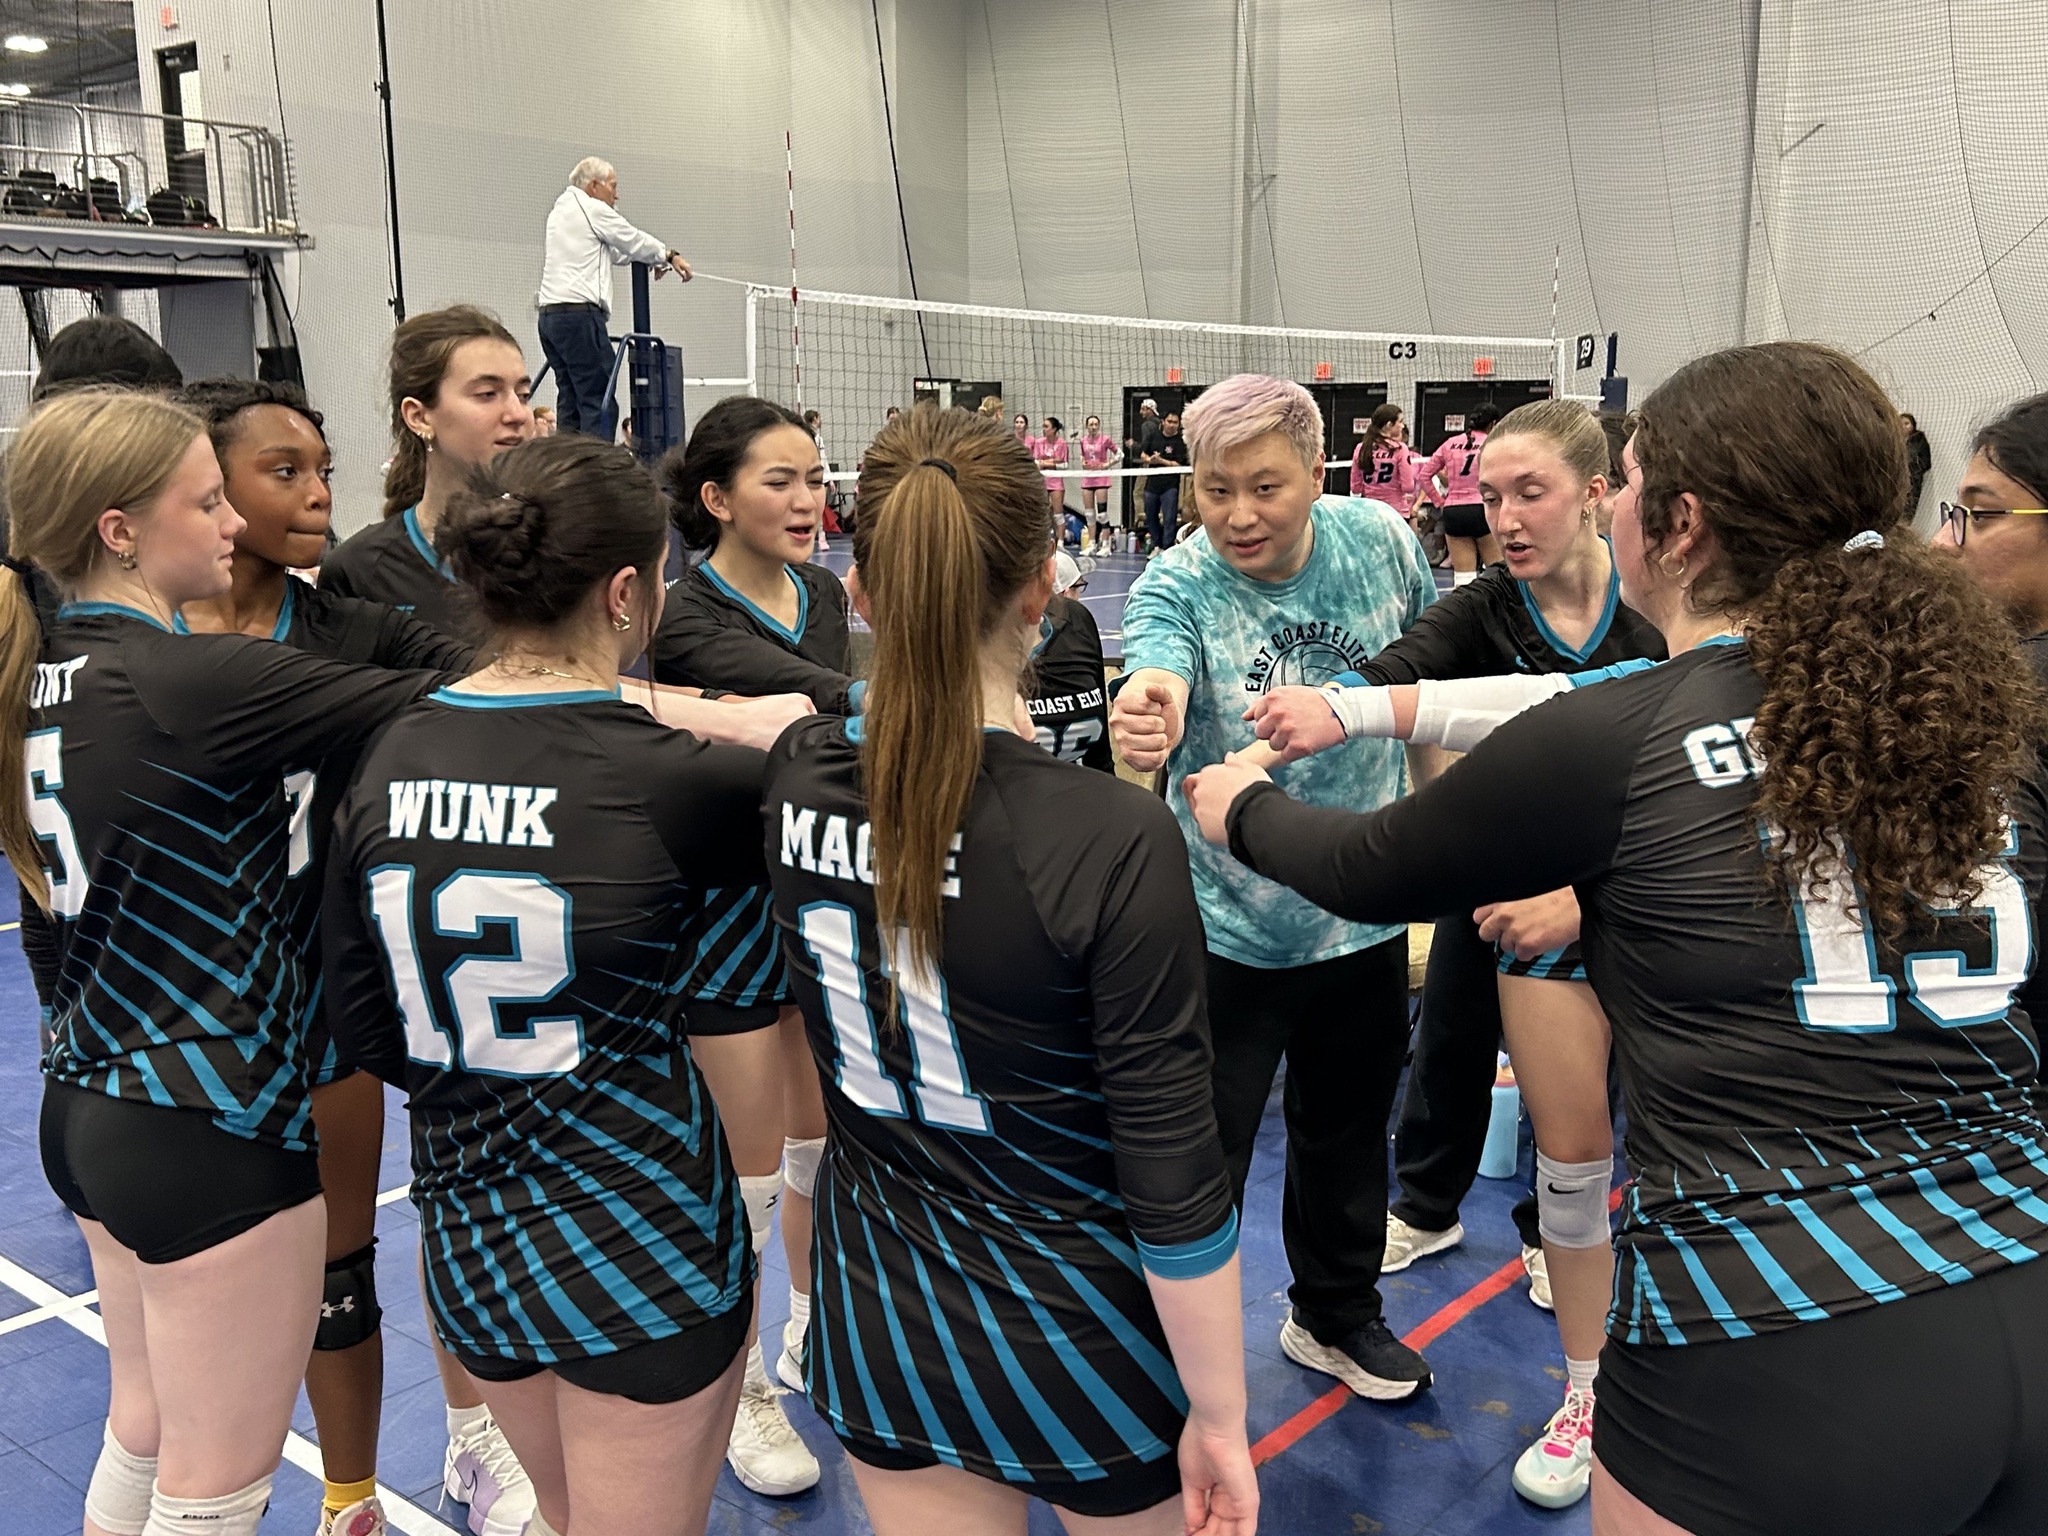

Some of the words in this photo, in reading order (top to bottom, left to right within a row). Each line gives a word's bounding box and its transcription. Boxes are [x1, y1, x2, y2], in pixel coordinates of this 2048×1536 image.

[1388, 341, 1417, 359] C3
[1460, 453, 1476, 476] 1
[1244, 646, 1274, 693] EAST
[1270, 621, 1329, 650] COAST
[1331, 625, 1369, 670] ELITE
[1025, 695, 1076, 716] COAST
[24, 725, 91, 922] 5
[388, 779, 559, 848] WUNK
[1754, 787, 2033, 1034] 15
[367, 862, 588, 1080] 12
[798, 900, 997, 1138] 11
